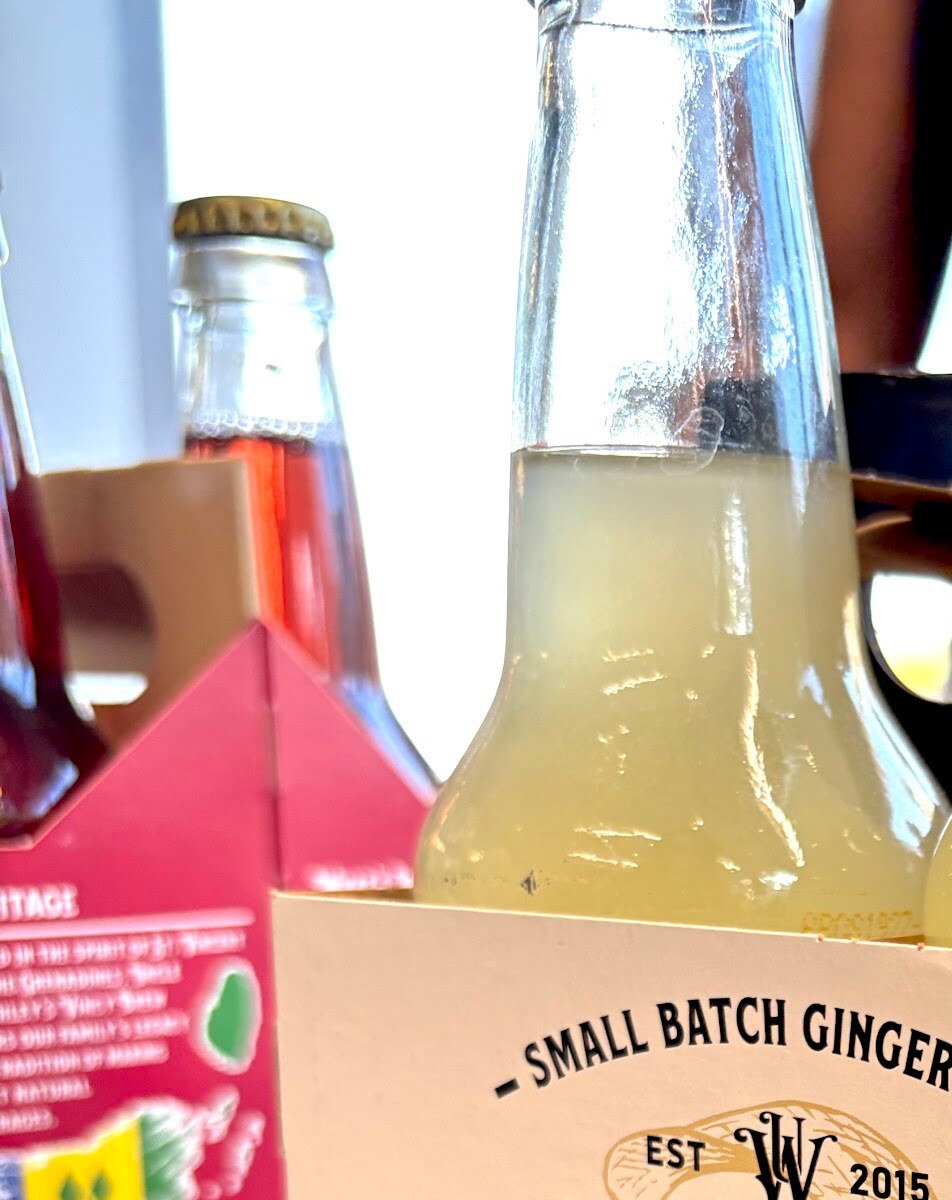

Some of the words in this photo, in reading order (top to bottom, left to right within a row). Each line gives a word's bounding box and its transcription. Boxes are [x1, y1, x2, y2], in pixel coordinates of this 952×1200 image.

[524, 1008, 649, 1090] SMALL
[655, 997, 788, 1049] BATCH
[645, 1134, 706, 1173] EST
